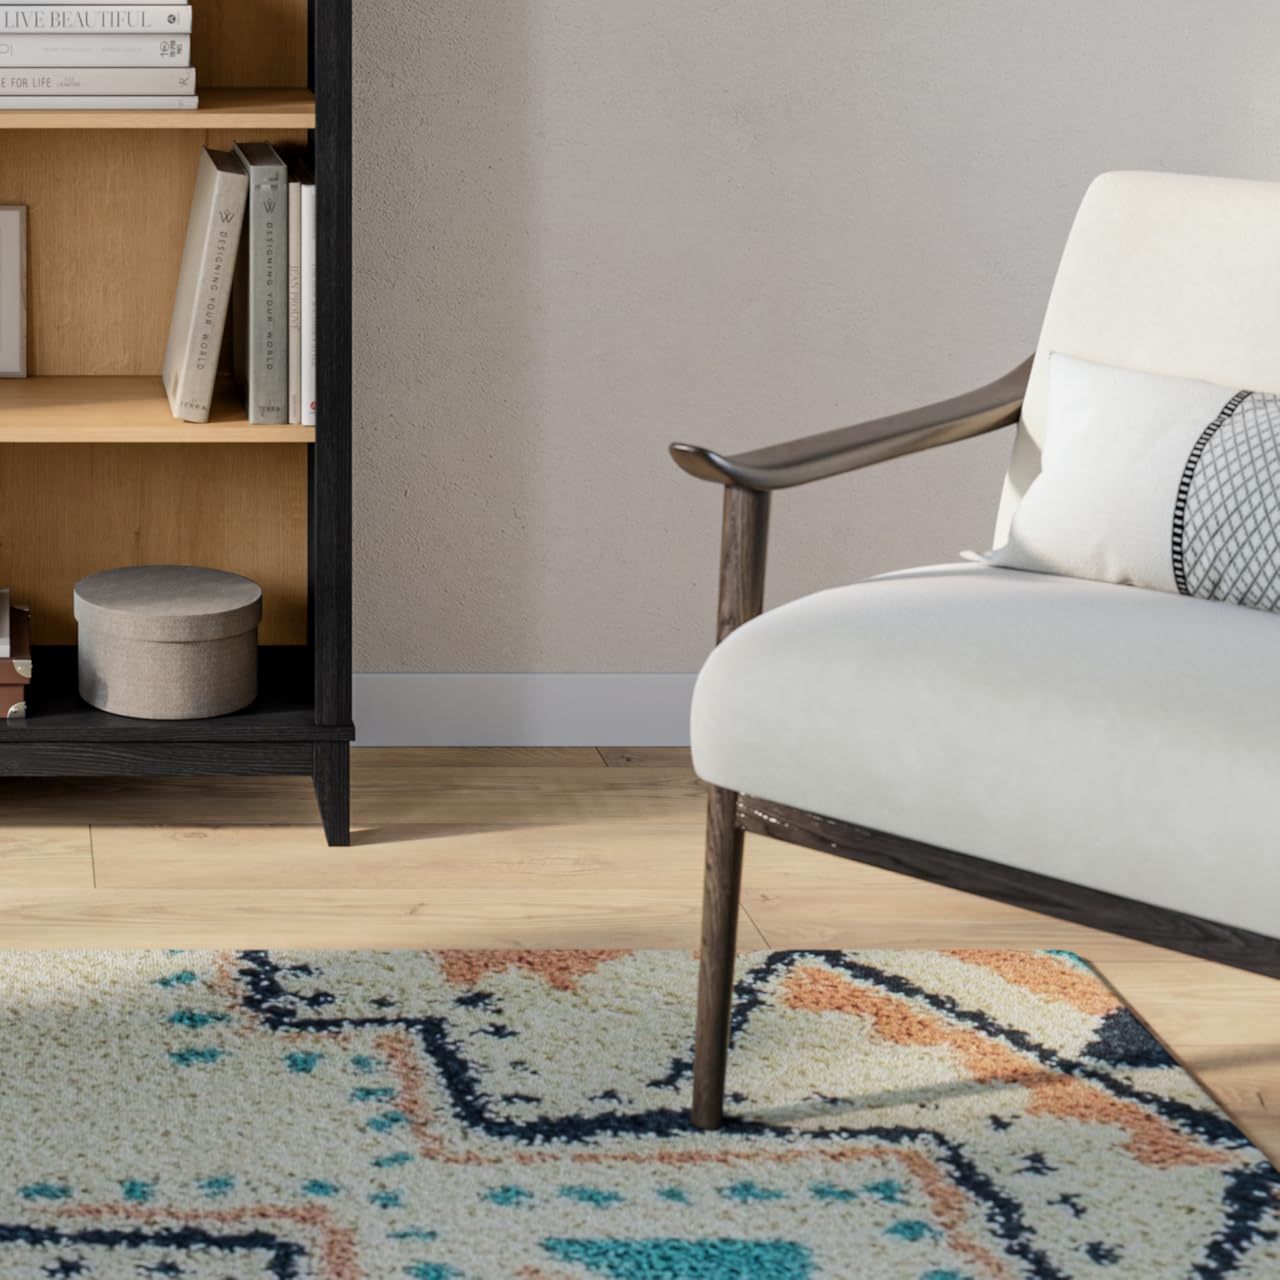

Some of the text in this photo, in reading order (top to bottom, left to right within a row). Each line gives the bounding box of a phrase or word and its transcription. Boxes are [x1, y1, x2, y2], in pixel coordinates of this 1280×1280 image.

[4, 10, 152, 28] LIVE BEAUTIFUL
[10, 78, 29, 88] FOR
[32, 78, 52, 88] LIFE
[197, 231, 228, 371] DESIGNING YOUR WORLD
